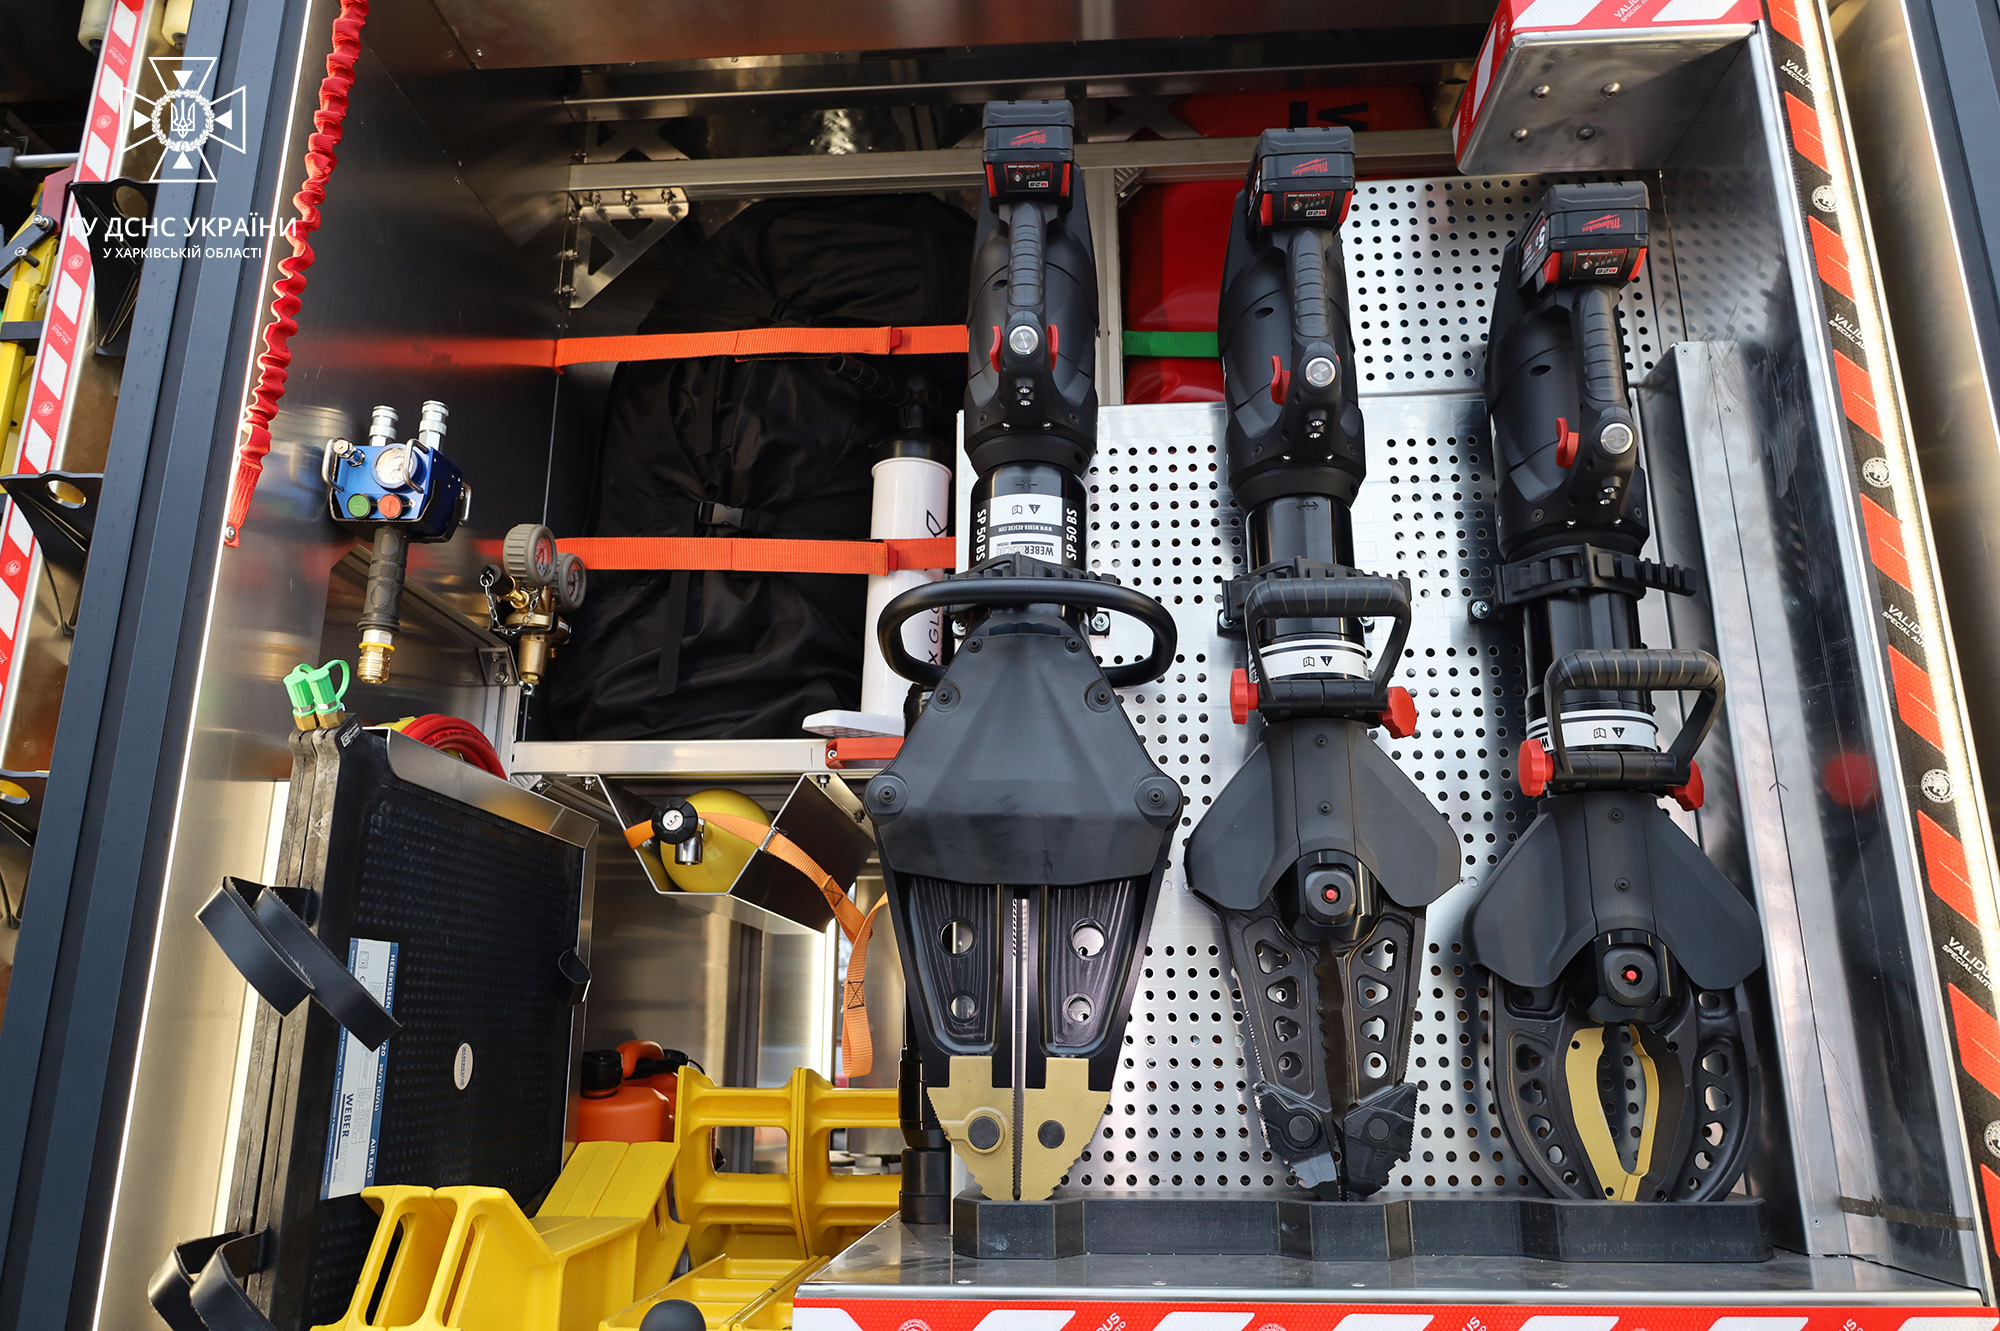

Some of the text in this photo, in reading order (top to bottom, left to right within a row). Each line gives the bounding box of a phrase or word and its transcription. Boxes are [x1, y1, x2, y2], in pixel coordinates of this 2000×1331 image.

[1581, 217, 1622, 233] Milwaukee
[1828, 319, 1855, 343] SPECIAL
[975, 508, 987, 562] SP 50 BS
[1066, 508, 1078, 561] SP 50 BS
[1881, 611, 1910, 637] SPECIAL
[1941, 944, 1973, 974] SPECIAL
[385, 954, 396, 1009] HEBEKISSEN
[367, 1157, 375, 1179] BAG
